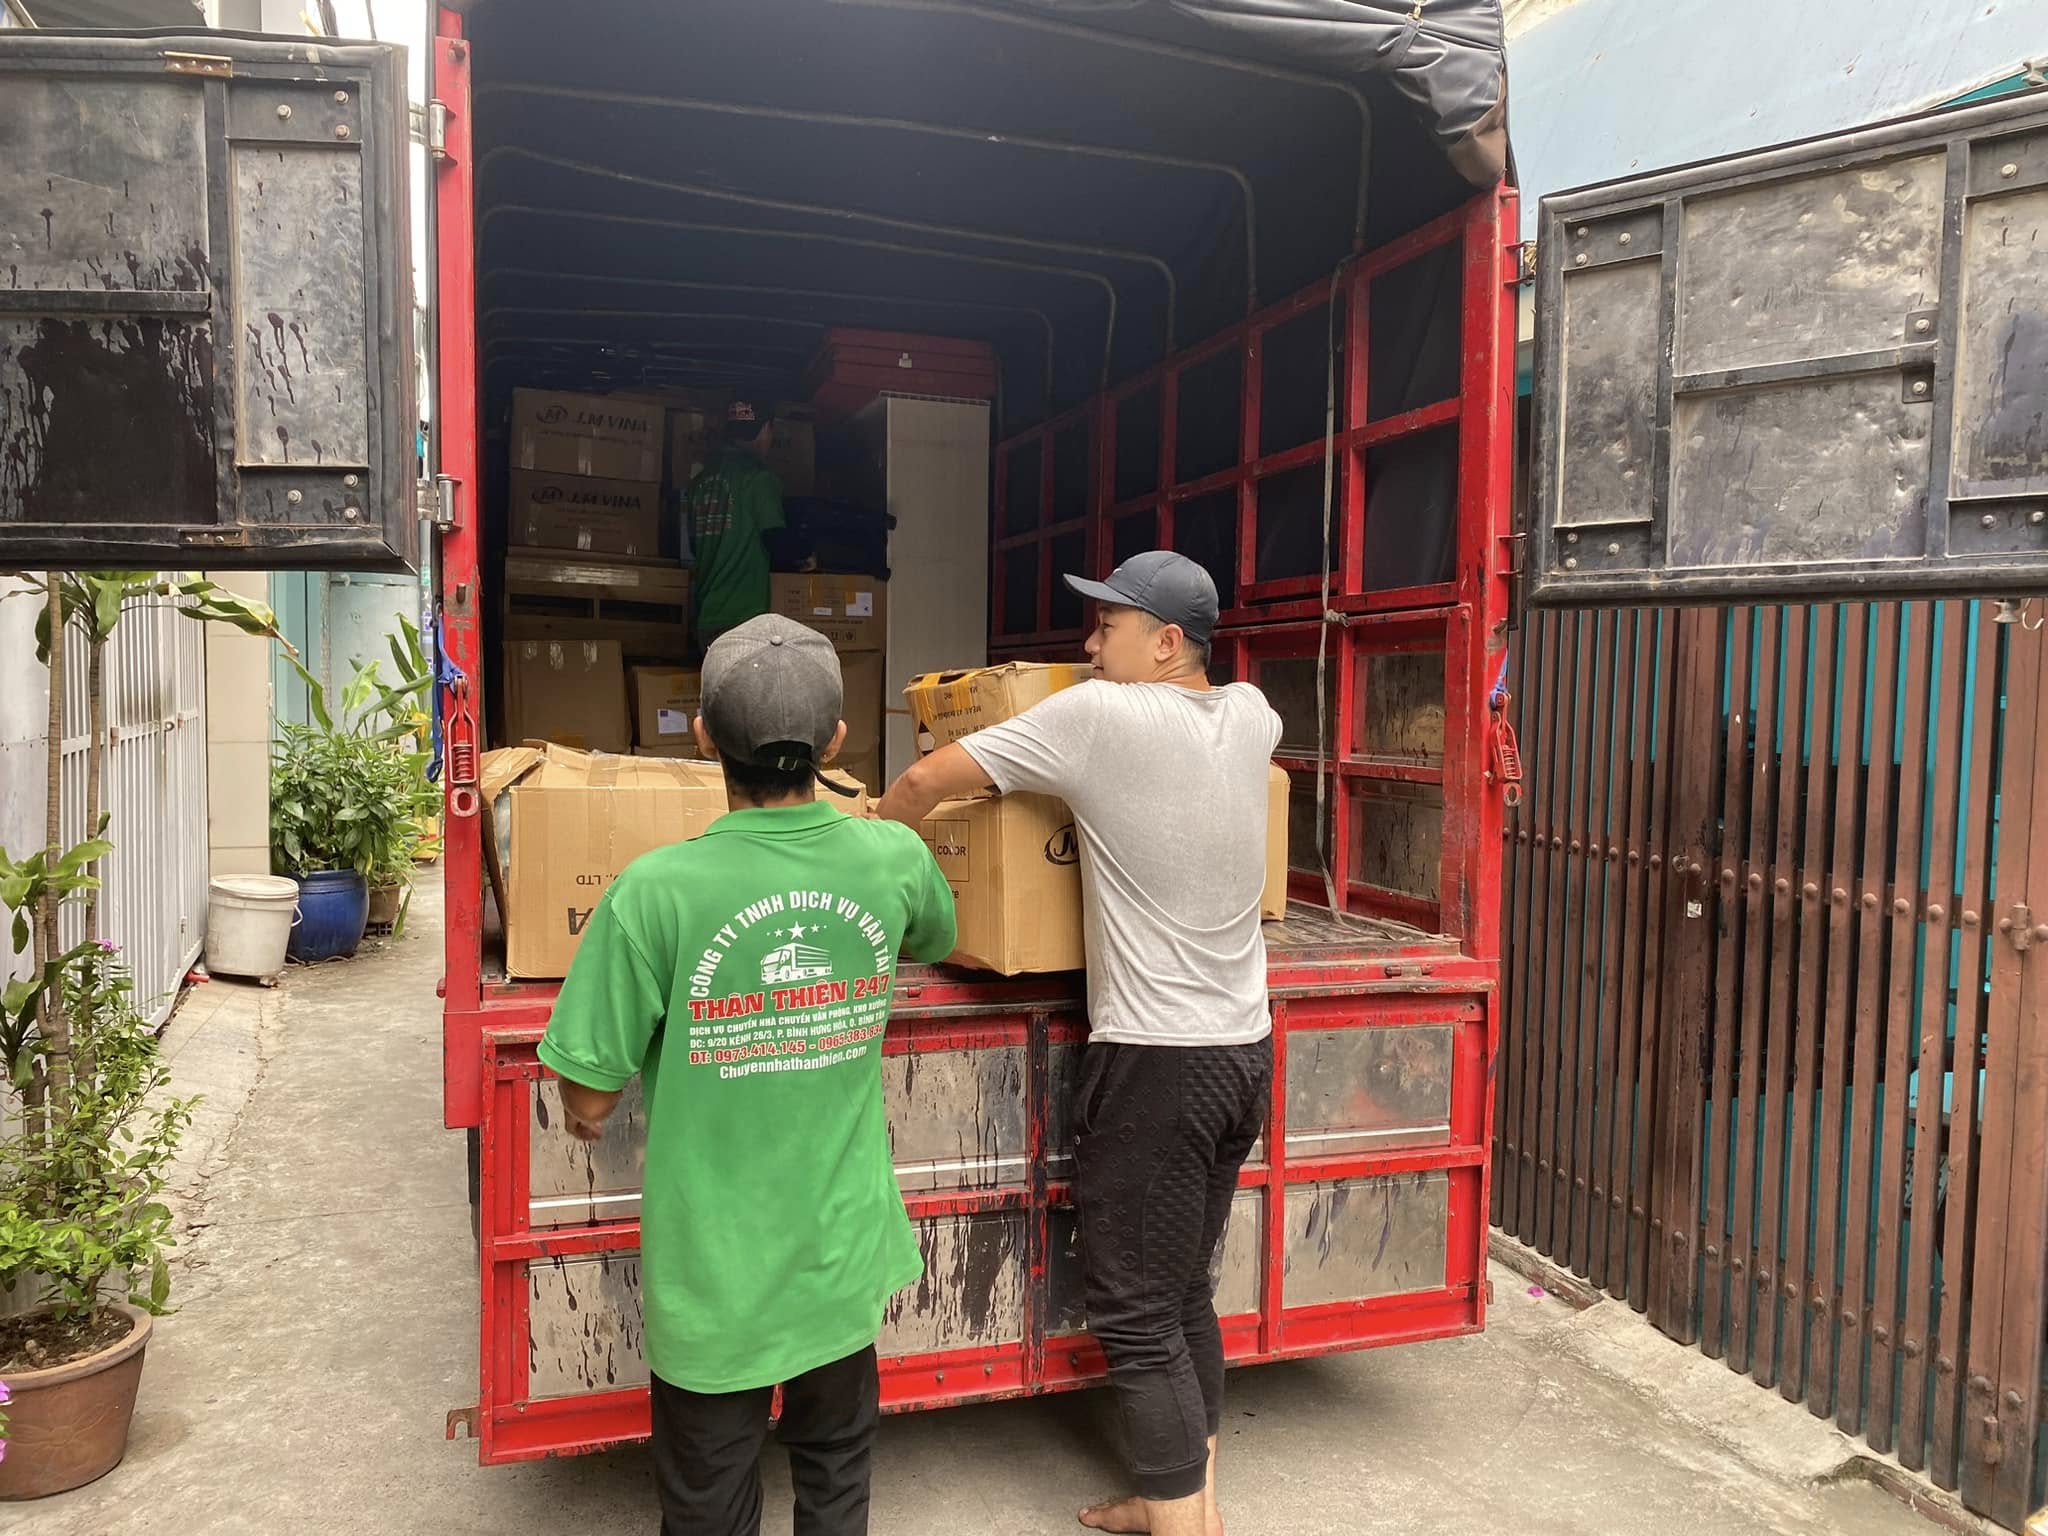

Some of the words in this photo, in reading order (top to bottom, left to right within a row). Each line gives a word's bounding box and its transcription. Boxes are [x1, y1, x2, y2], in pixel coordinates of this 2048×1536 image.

[576, 875, 601, 885] LTD
[689, 948, 723, 998] CÔNG
[712, 923, 738, 948] TY
[734, 894, 785, 928] TNHH
[789, 890, 833, 912] DỊCH
[836, 896, 860, 922] VỤ
[857, 911, 886, 947] VẬN
[874, 945, 892, 974] TẢI
[688, 992, 765, 1021] THÂN
[771, 979, 848, 1009] THIỆN
[853, 972, 891, 999] 247
[707, 1037, 727, 1047] 9/20
[786, 1026, 808, 1037] BÌNH
[689, 1050, 712, 1064] ĐT:
[714, 1039, 806, 1063] 0973.414.145
[719, 1045, 867, 1079] Chuyennhathanthien.com
